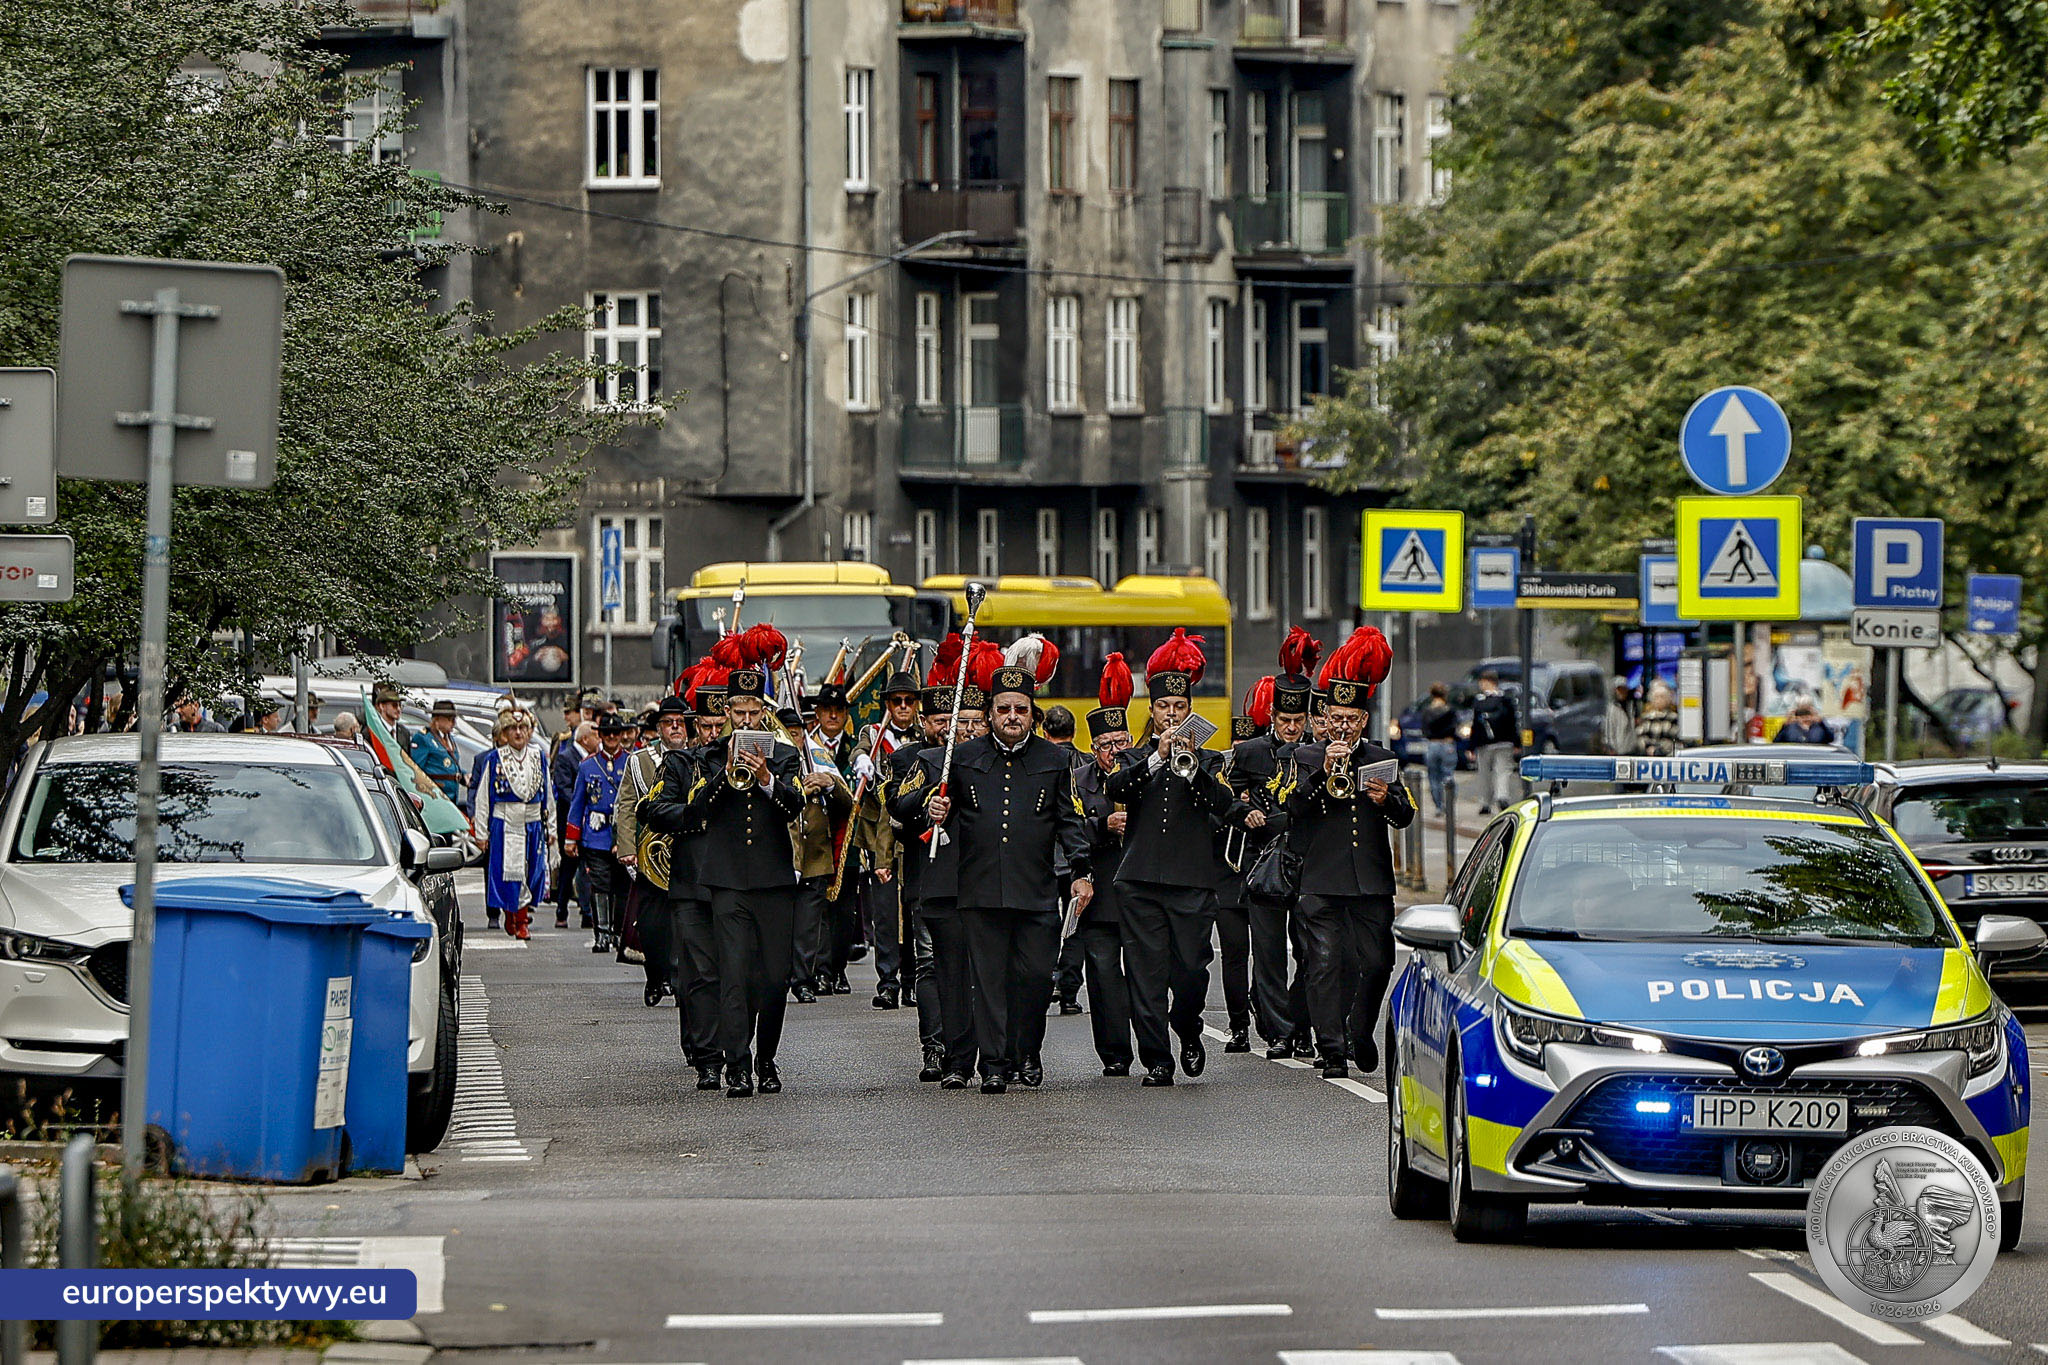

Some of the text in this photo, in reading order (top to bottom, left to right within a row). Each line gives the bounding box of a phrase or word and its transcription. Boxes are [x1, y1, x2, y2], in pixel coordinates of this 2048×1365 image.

[1871, 528, 1923, 598] P
[1892, 584, 1938, 602] Płatny
[1856, 617, 1937, 640] Konie
[1636, 760, 1729, 783] POLICJA
[1977, 875, 1999, 892] SK
[1647, 978, 1865, 1007] POLICJA
[1681, 1114, 1693, 1124] PL
[1700, 1098, 1842, 1129] HPP K209
